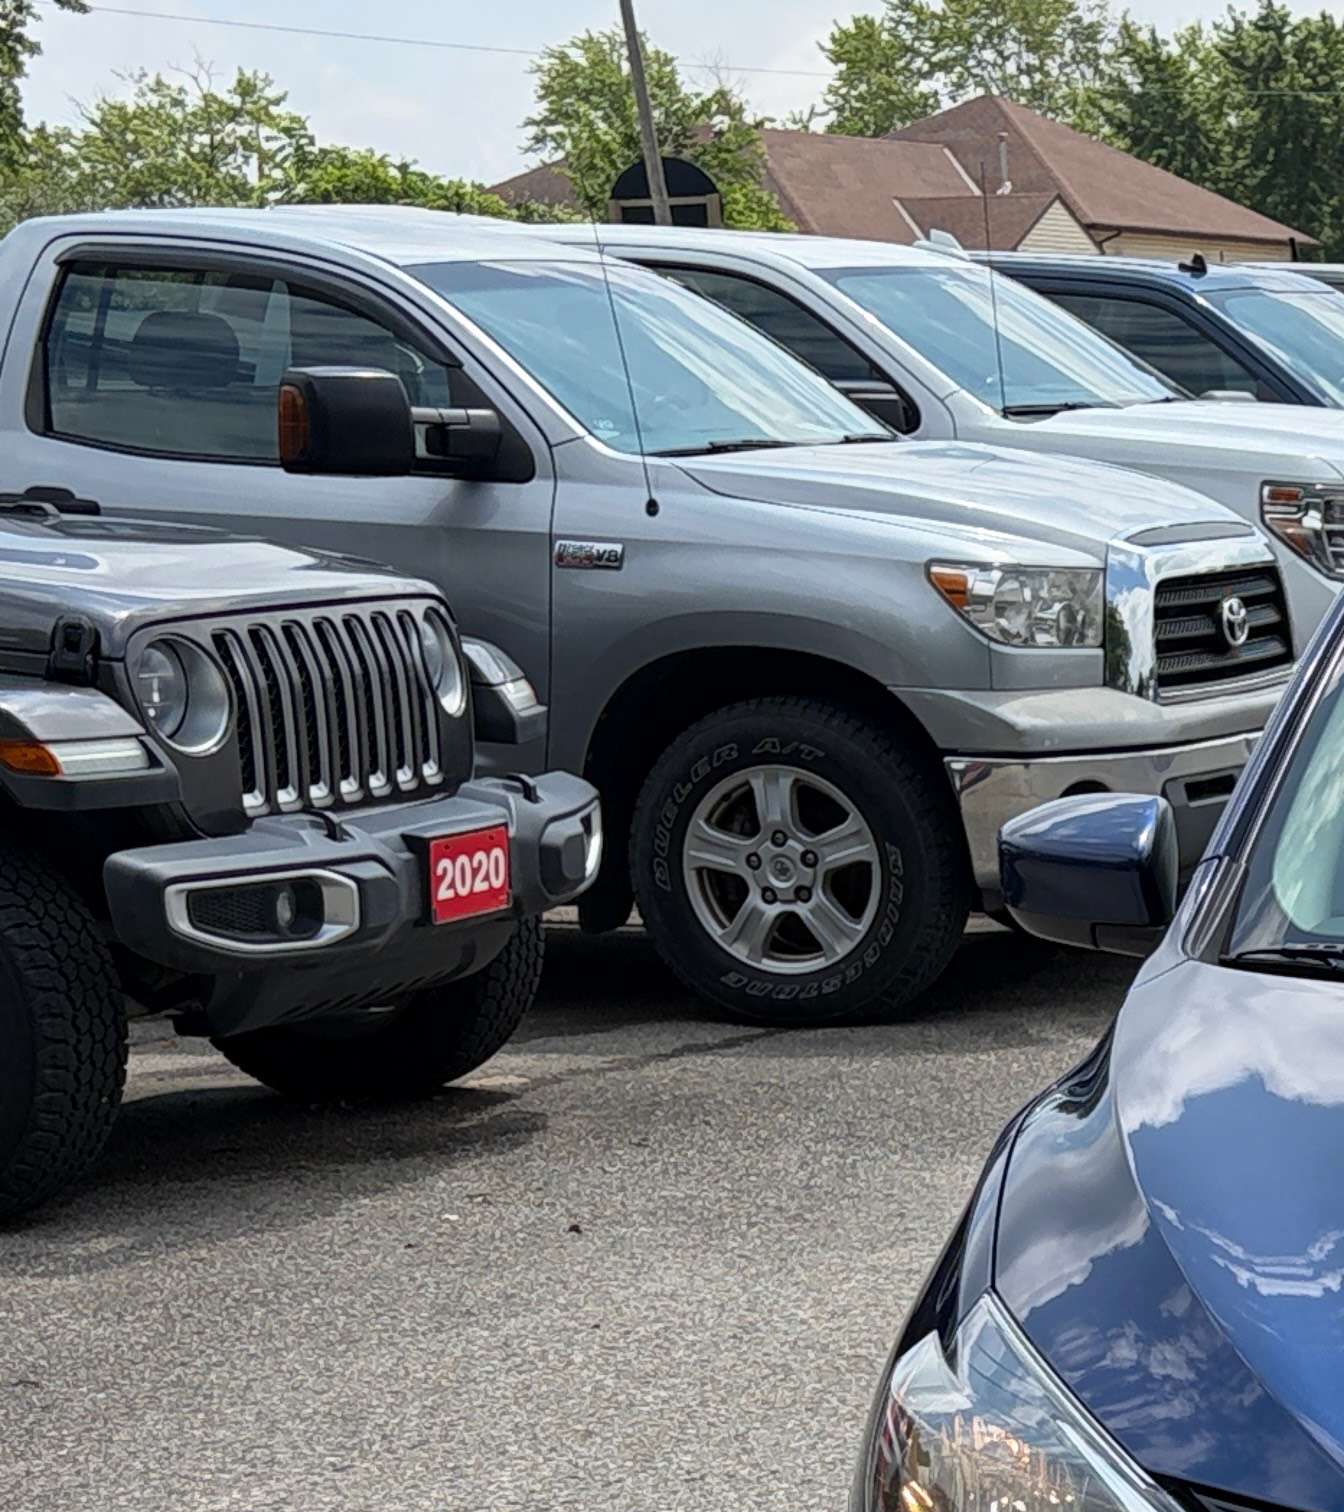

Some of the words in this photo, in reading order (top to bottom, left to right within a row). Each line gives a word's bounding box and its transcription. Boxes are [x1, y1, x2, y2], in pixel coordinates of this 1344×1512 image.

[595, 548, 619, 562] V8
[653, 743, 739, 891] DUELER
[752, 737, 825, 761] A/T
[436, 847, 506, 901] 2020
